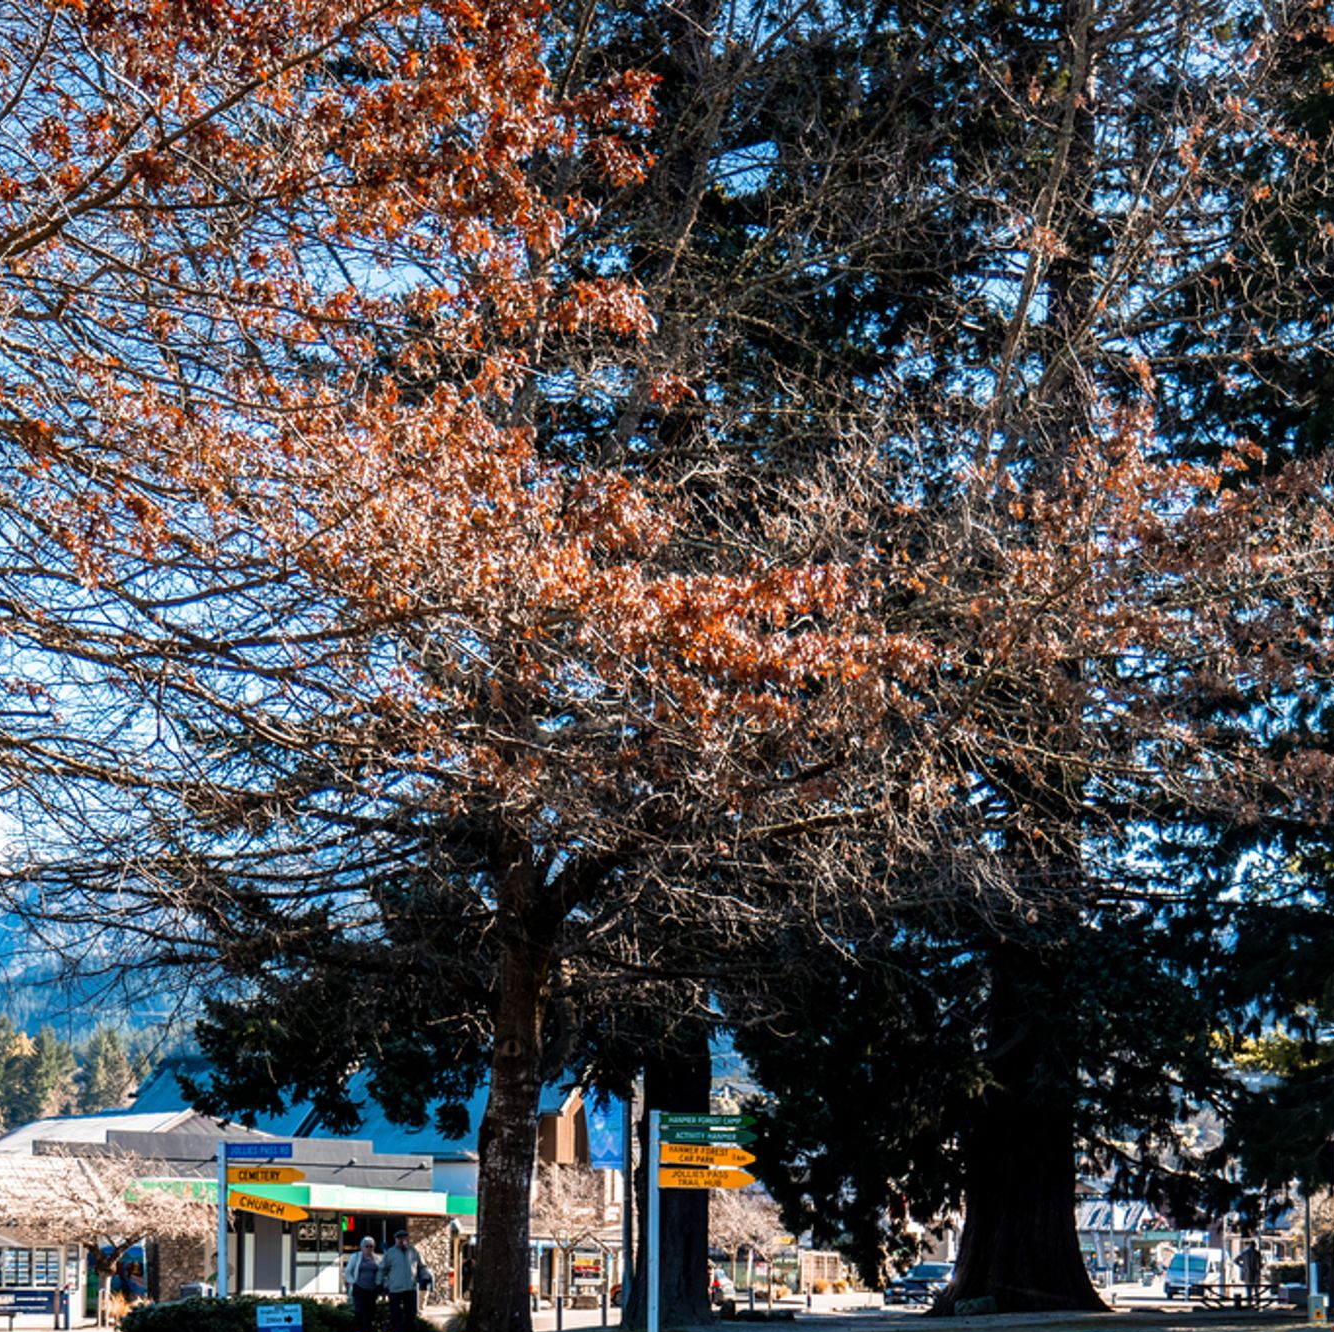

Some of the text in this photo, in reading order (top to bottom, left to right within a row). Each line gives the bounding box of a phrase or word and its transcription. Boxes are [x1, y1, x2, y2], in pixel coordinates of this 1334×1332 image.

[723, 1116, 742, 1125] CAMP
[706, 1132, 737, 1140] HANMER
[230, 1146, 258, 1155] JOLLIES
[260, 1146, 278, 1155] PASS
[668, 1146, 728, 1156] HANMER FOREST
[679, 1154, 715, 1164] CAR PARK
[238, 1170, 281, 1181] CEMETERY
[671, 1170, 729, 1179] JOLLIES PASS
[703, 1179, 722, 1187] HUB
[239, 1196, 285, 1216] CHURCH
